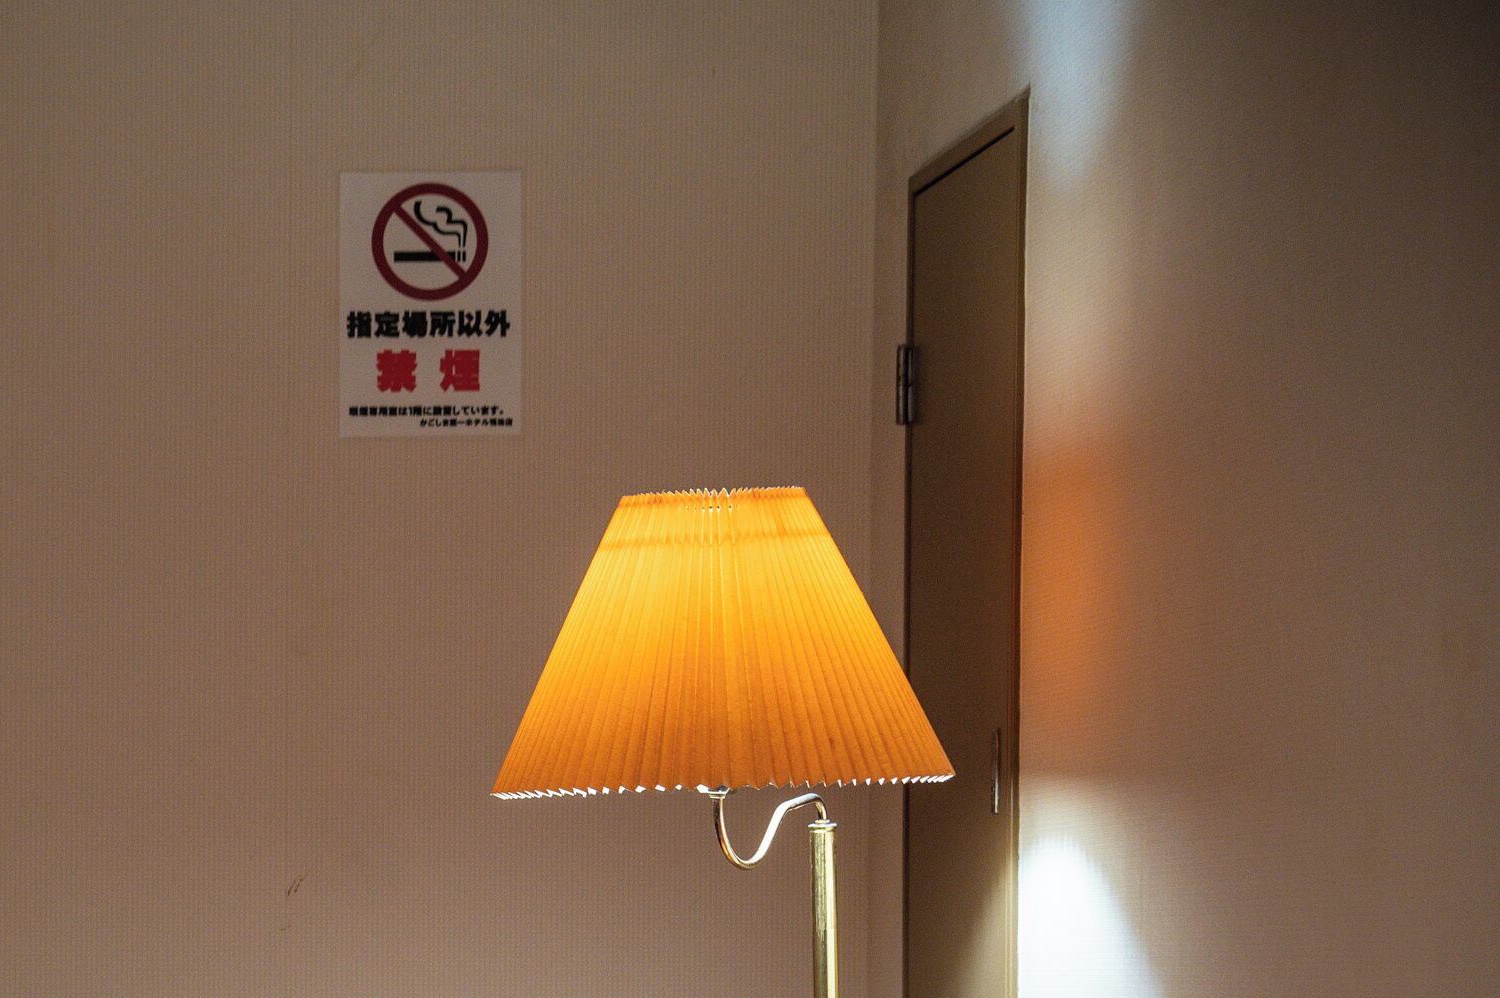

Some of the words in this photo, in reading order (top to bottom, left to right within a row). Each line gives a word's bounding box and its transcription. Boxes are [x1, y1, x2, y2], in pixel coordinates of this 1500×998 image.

[347, 310, 511, 338] 指定場所以外
[376, 349, 480, 393] 禁煙
